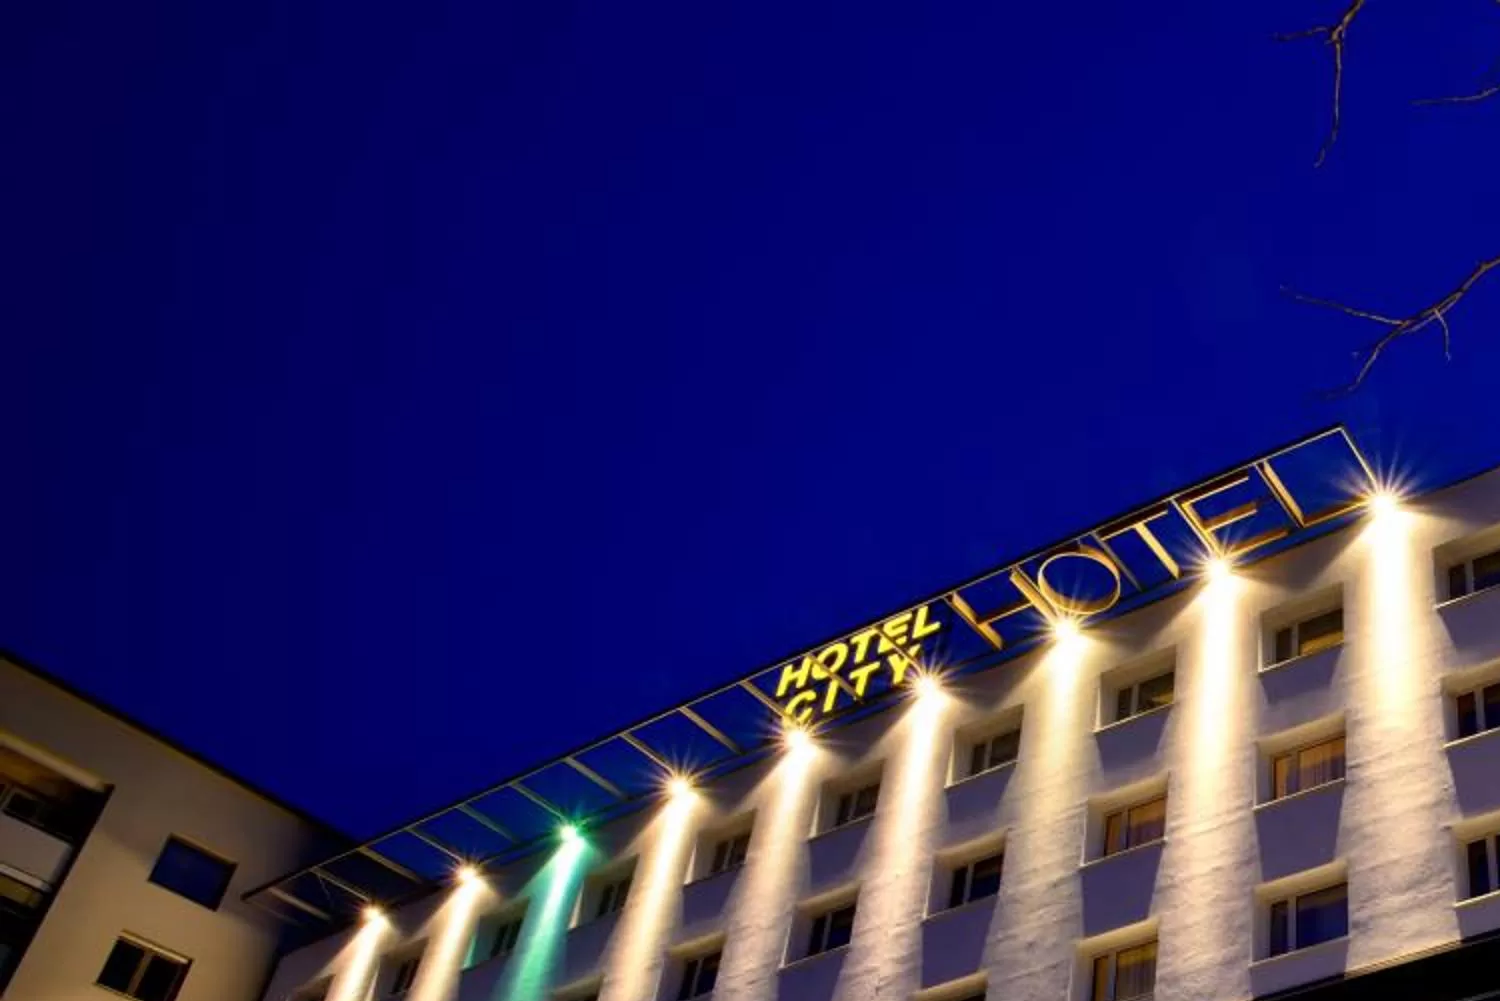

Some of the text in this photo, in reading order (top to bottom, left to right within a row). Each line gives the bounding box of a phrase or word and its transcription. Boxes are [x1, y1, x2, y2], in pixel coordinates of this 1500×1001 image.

[948, 459, 1374, 650] HOTEL
[776, 605, 941, 697] HOTEL
[784, 644, 920, 724] CITY
